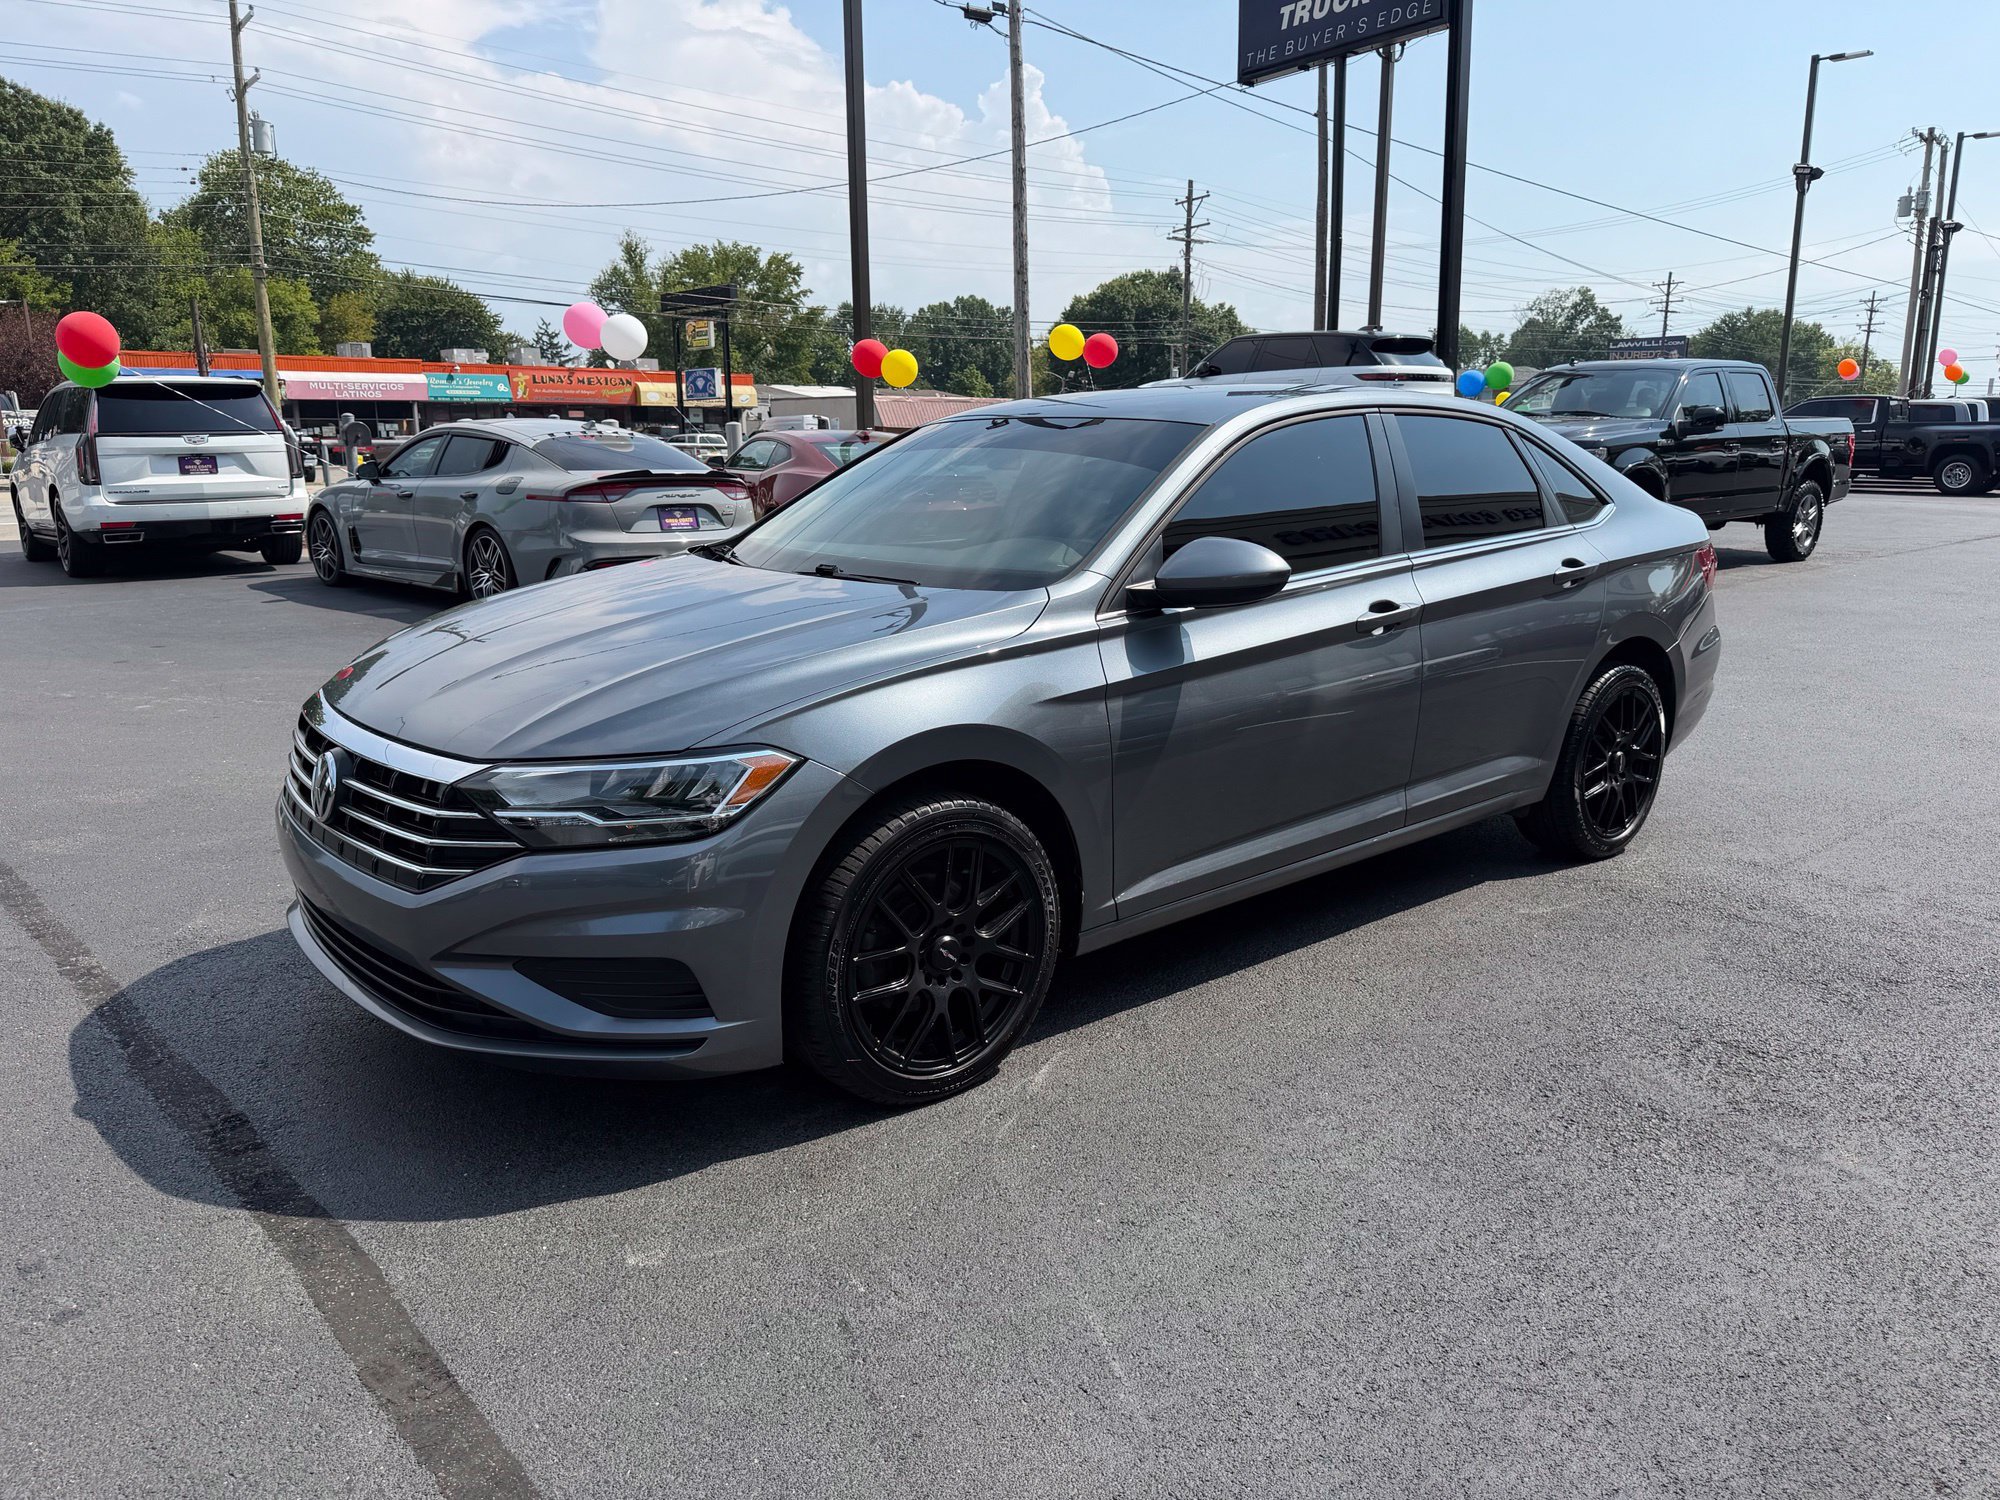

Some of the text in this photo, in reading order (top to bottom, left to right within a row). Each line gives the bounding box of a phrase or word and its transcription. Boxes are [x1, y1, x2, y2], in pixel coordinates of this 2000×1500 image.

[1246, 2, 1431, 67] THE BUYER'S EDGE
[1609, 350, 1661, 360] INJURED?
[463, 377, 493, 387] Jewelry
[531, 374, 633, 387] LUNA'S MEXICAN
[309, 382, 405, 390] MULTI-SERVICIOS
[335, 390, 382, 398] LATINOS
